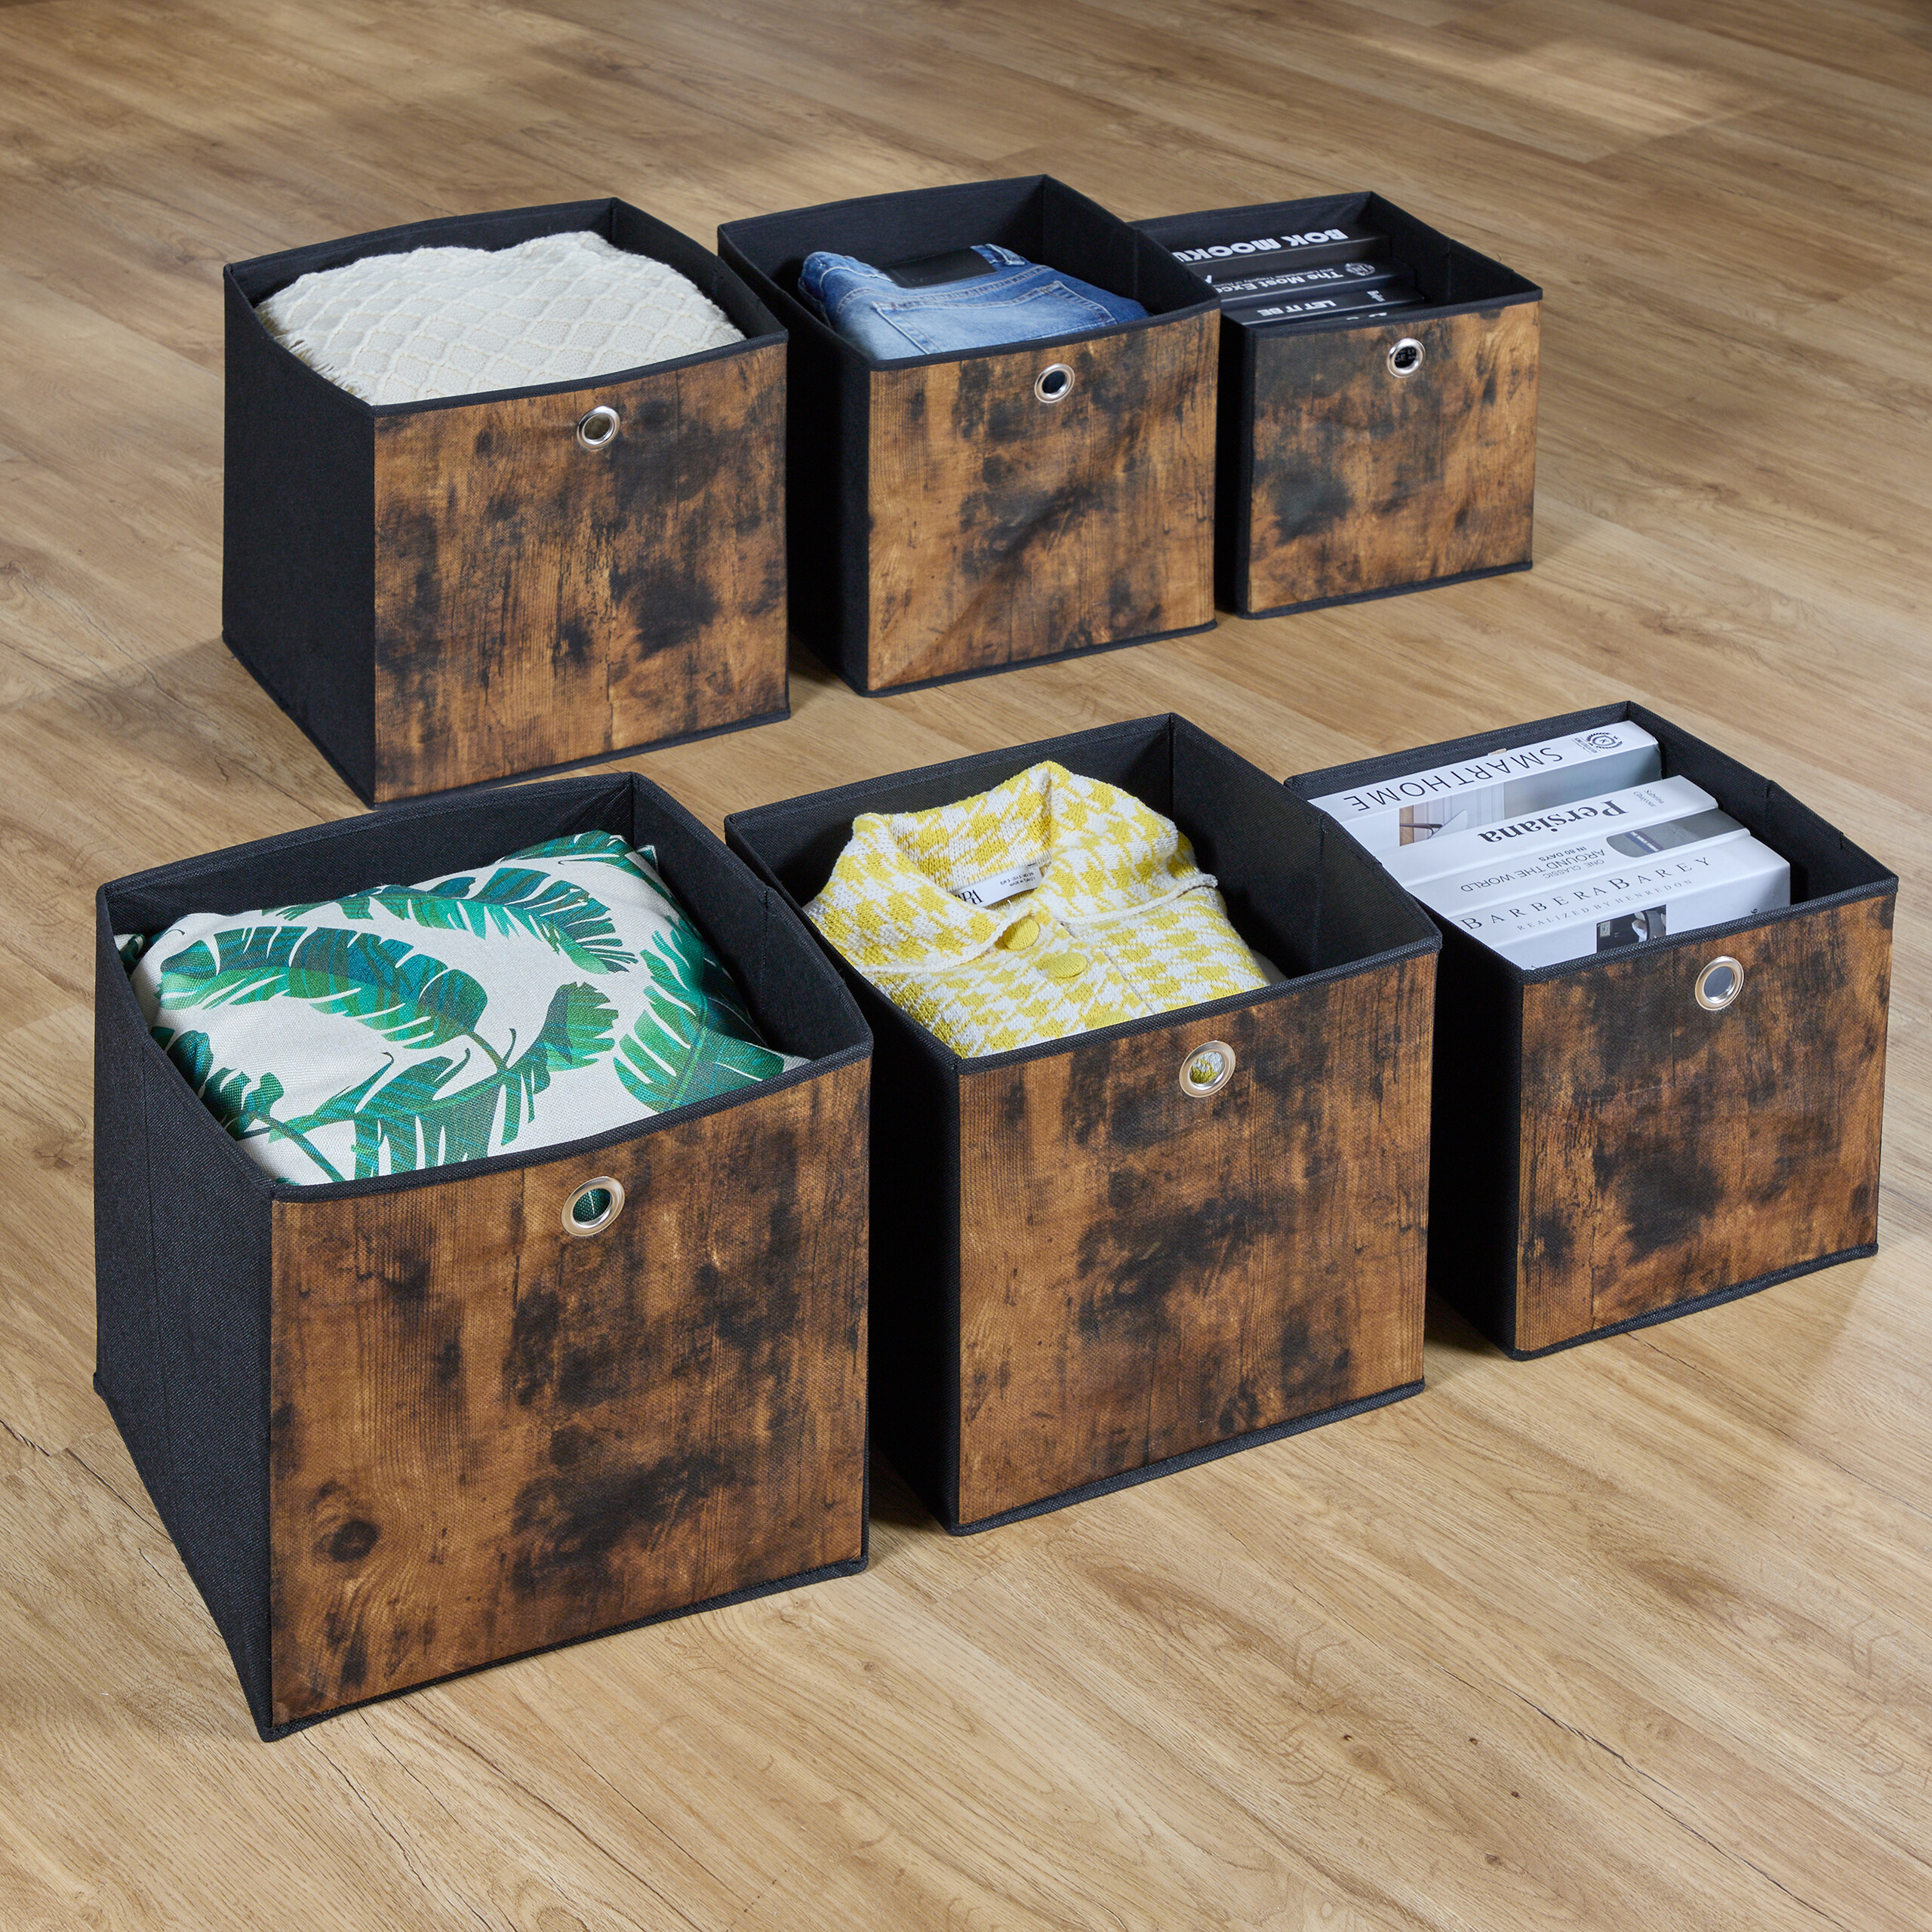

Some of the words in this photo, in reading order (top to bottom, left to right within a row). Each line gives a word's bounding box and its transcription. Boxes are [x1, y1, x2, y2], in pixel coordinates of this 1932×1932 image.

[1280, 229, 1349, 247] BOK
[1307, 271, 1344, 280] The
[1258, 276, 1306, 288] Most
[1284, 305, 1303, 313] IT
[1304, 300, 1337, 311] LET
[1257, 307, 1284, 317] BE
[1477, 799, 1629, 843] Persiana
[1538, 852, 1564, 862] DAYS
[1546, 848, 1605, 869] AROUND
[1583, 858, 1605, 867] ONE
[1513, 866, 1547, 878] THE
[1542, 865, 1582, 878] CLASSIC
[1460, 873, 1516, 892] WORLD
